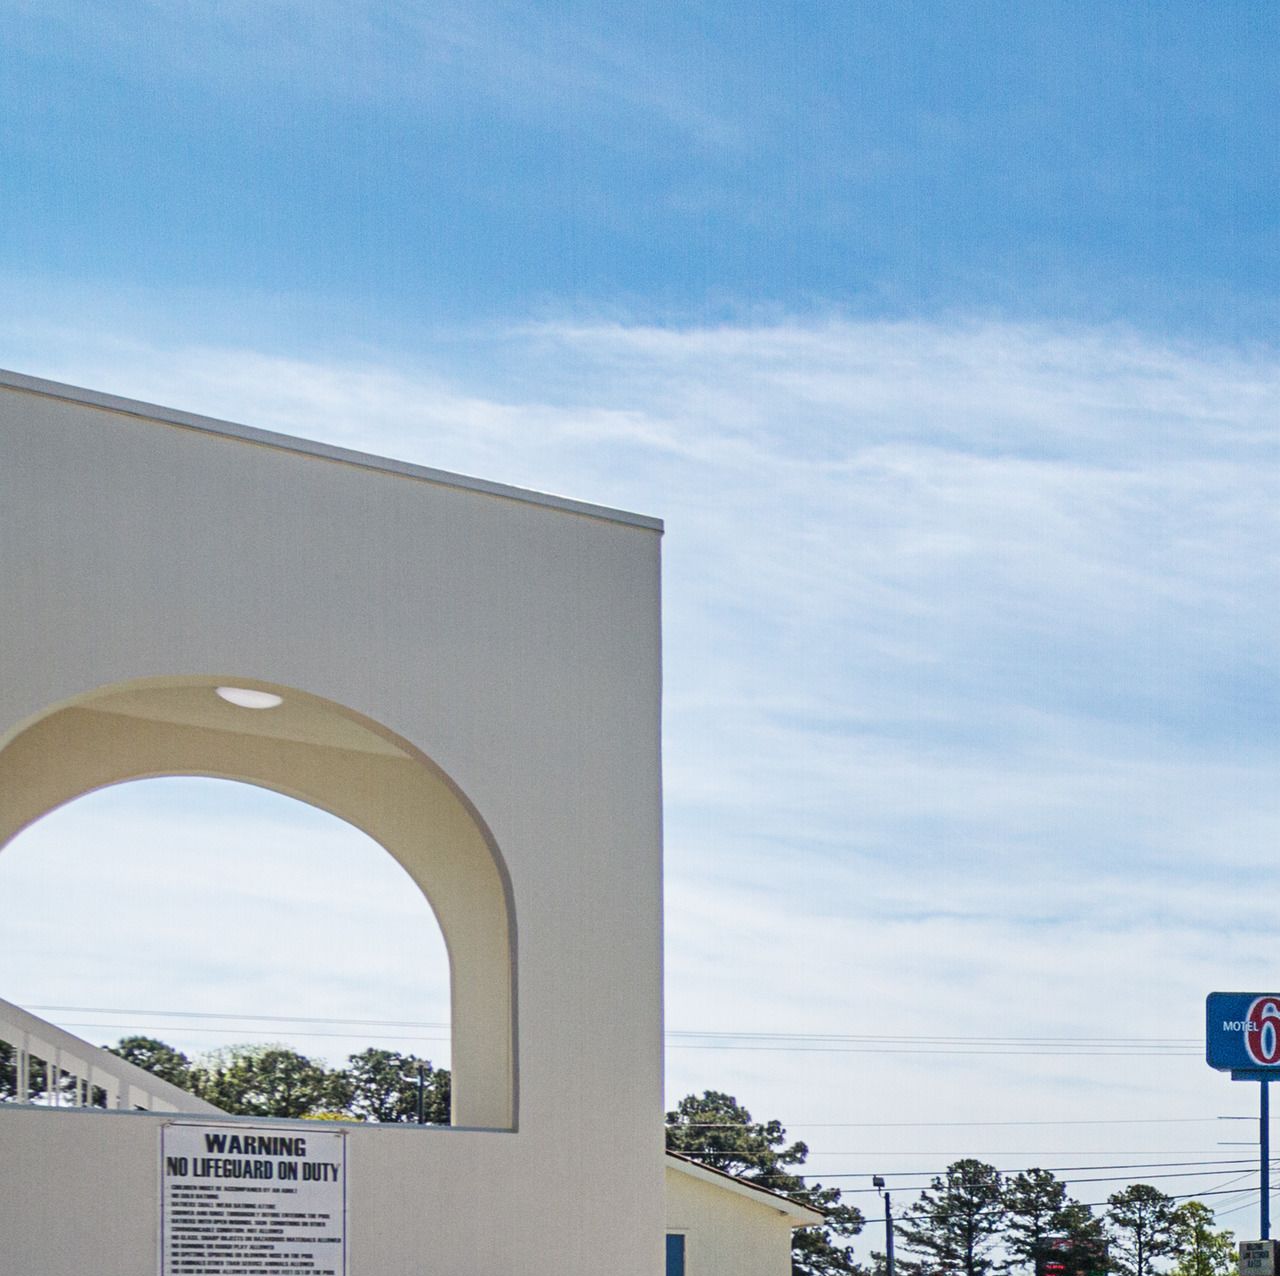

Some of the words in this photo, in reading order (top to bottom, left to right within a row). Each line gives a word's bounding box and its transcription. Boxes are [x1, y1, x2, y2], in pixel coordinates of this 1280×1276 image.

[1223, 1021, 1259, 1032] MOTEL
[204, 1133, 306, 1157] WARNING
[167, 1157, 188, 1177] NO
[193, 1158, 273, 1180] LIFEGUARD
[278, 1161, 298, 1180] ON
[303, 1162, 339, 1182] DUTY
